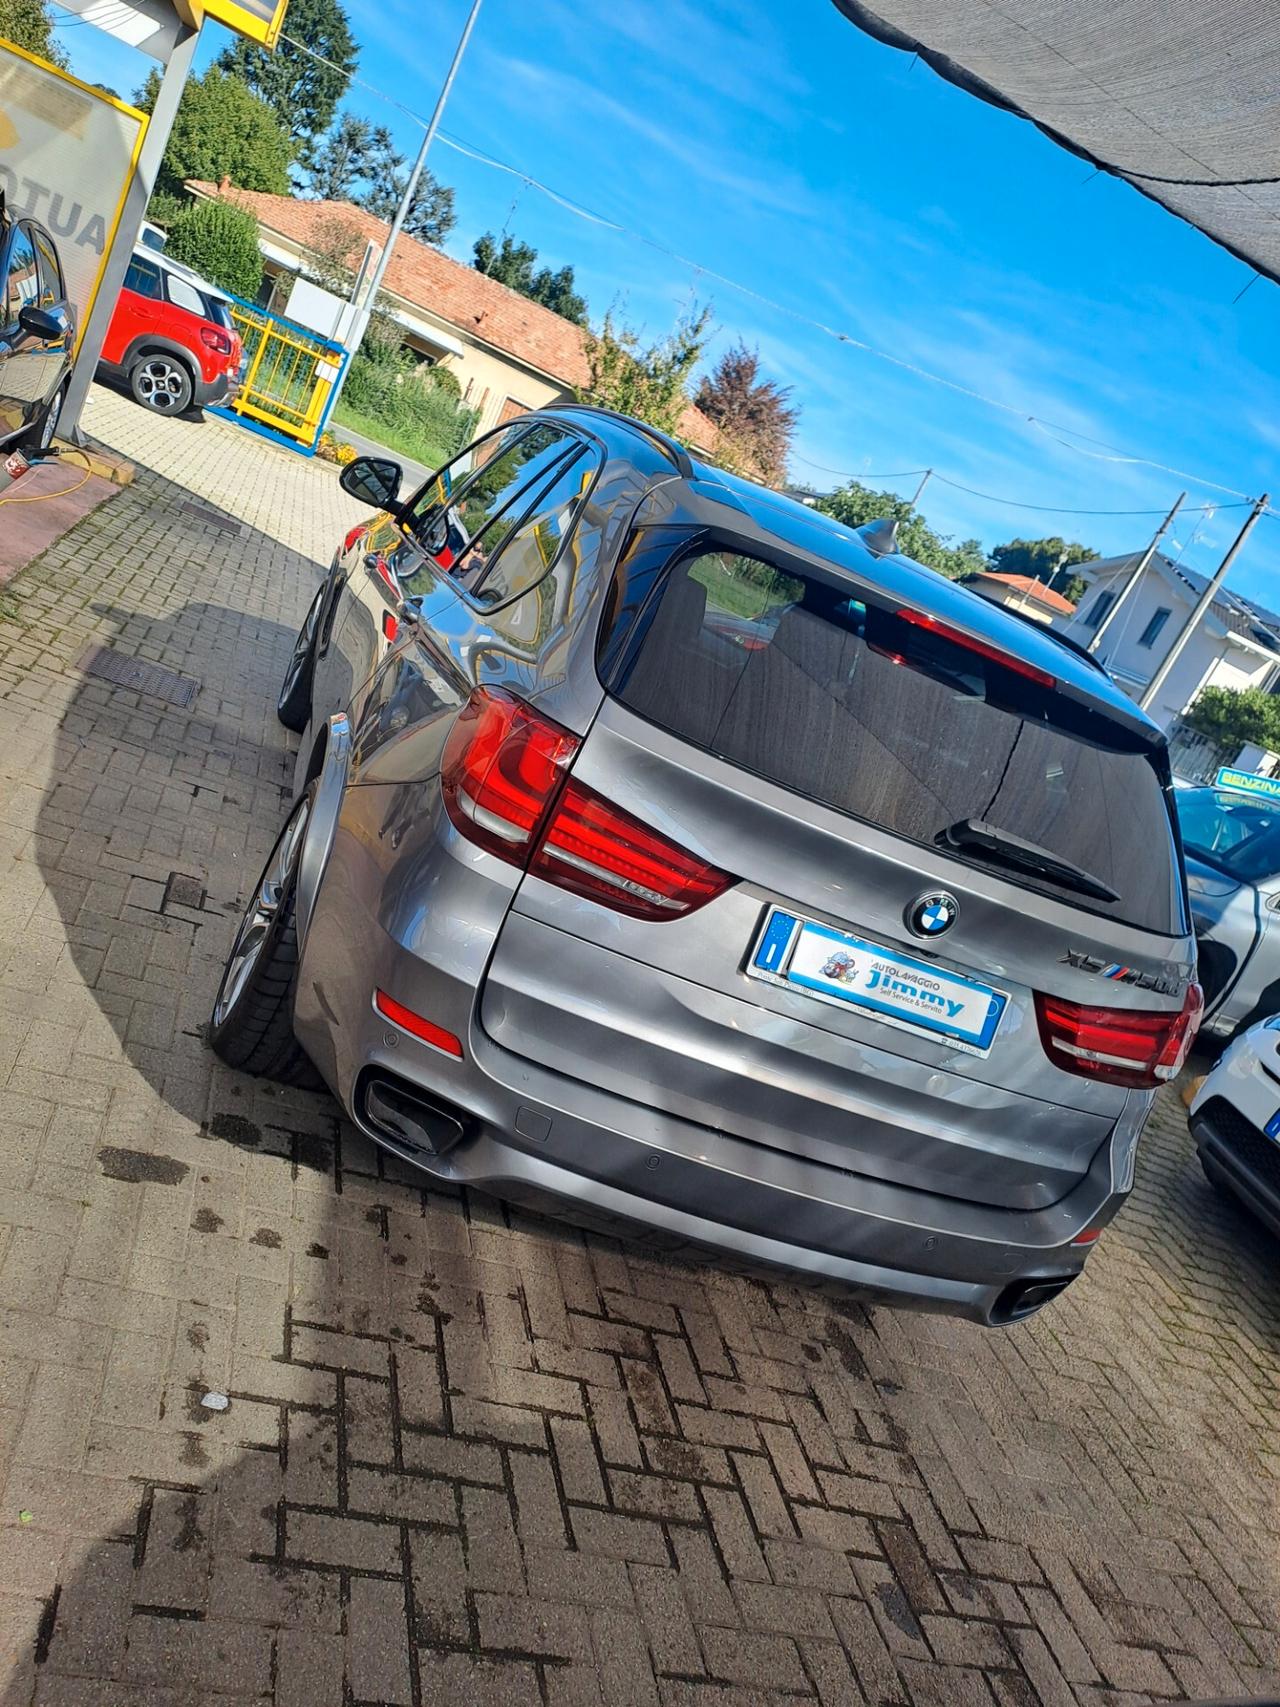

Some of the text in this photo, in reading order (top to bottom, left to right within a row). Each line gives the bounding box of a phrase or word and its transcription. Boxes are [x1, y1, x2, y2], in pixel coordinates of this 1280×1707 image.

[871, 962, 941, 991] AUTOLAVAGGIO
[865, 969, 965, 1018] Jimmy
[880, 987, 892, 997] Self
[892, 990, 915, 1004] Service
[920, 1000, 943, 1014] Servito
